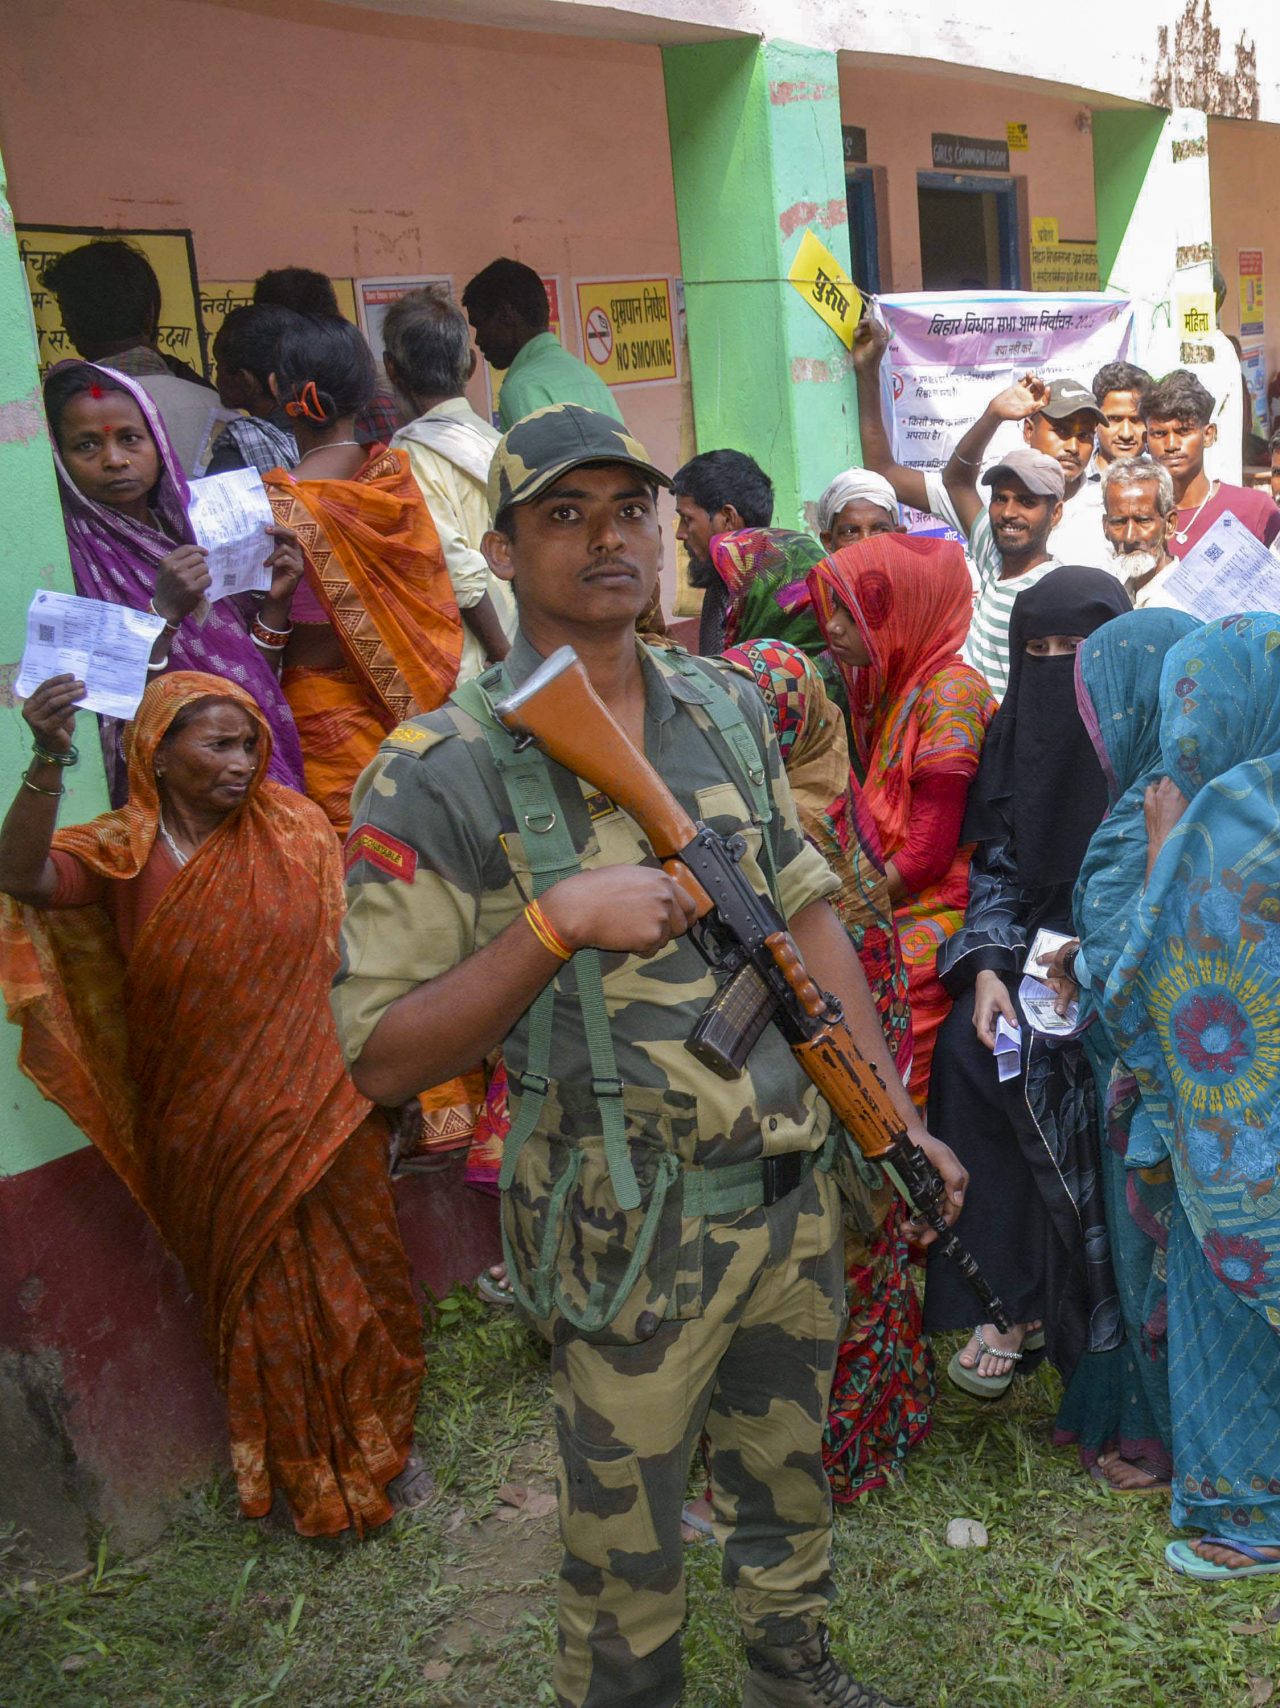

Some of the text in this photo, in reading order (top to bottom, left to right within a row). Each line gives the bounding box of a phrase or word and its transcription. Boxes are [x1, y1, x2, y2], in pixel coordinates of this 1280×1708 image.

[928, 313, 962, 336] बिहार
[962, 312, 995, 335] विधान
[996, 316, 1017, 334] सभा
[1019, 316, 1037, 333] आम
[1184, 307, 1209, 332] महिला
[615, 338, 672, 371] NO SMOKING
[362, 837, 402, 863] CONSTABLE
